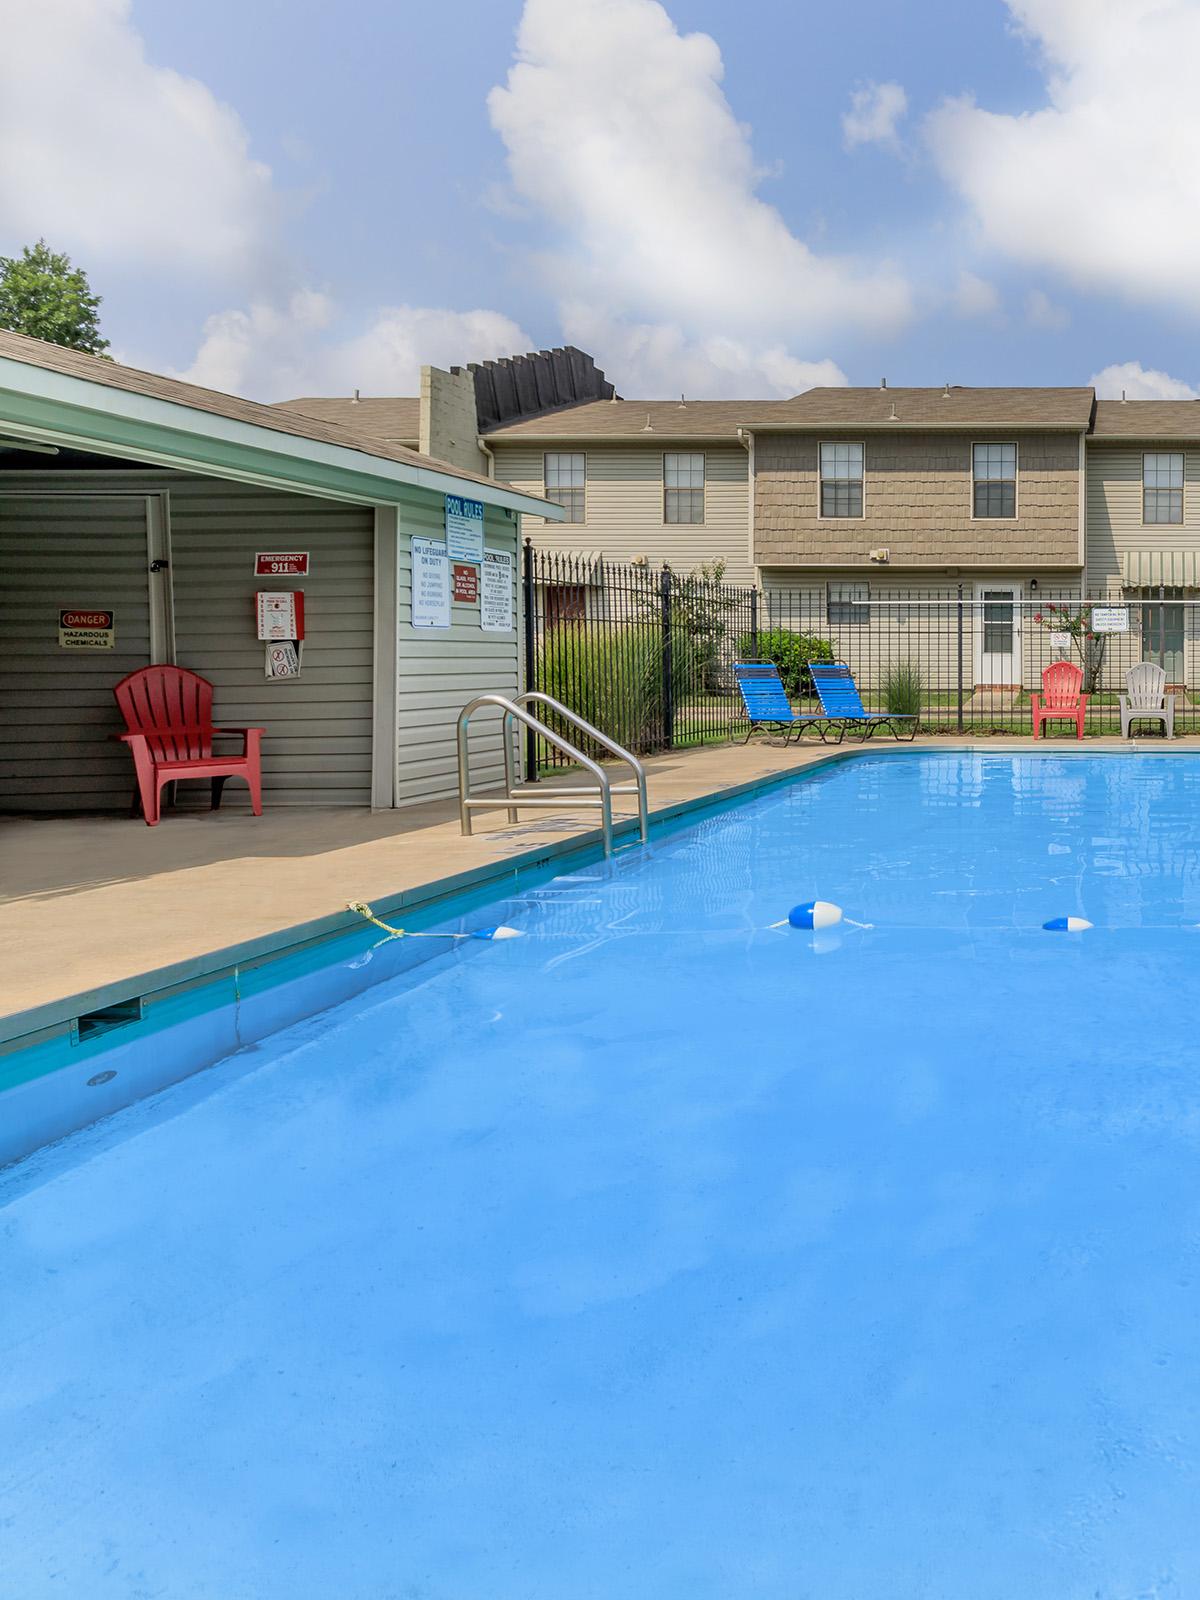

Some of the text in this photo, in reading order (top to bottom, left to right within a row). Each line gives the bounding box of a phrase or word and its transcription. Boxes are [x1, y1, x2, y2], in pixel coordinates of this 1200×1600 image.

[447, 497, 482, 519] POOL RULES
[415, 545, 448, 558] NO LIFEGUARD
[421, 556, 442, 566] ON DUTY
[483, 553, 494, 562] POOL
[271, 562, 289, 573] 911
[67, 615, 105, 624] DANGER
